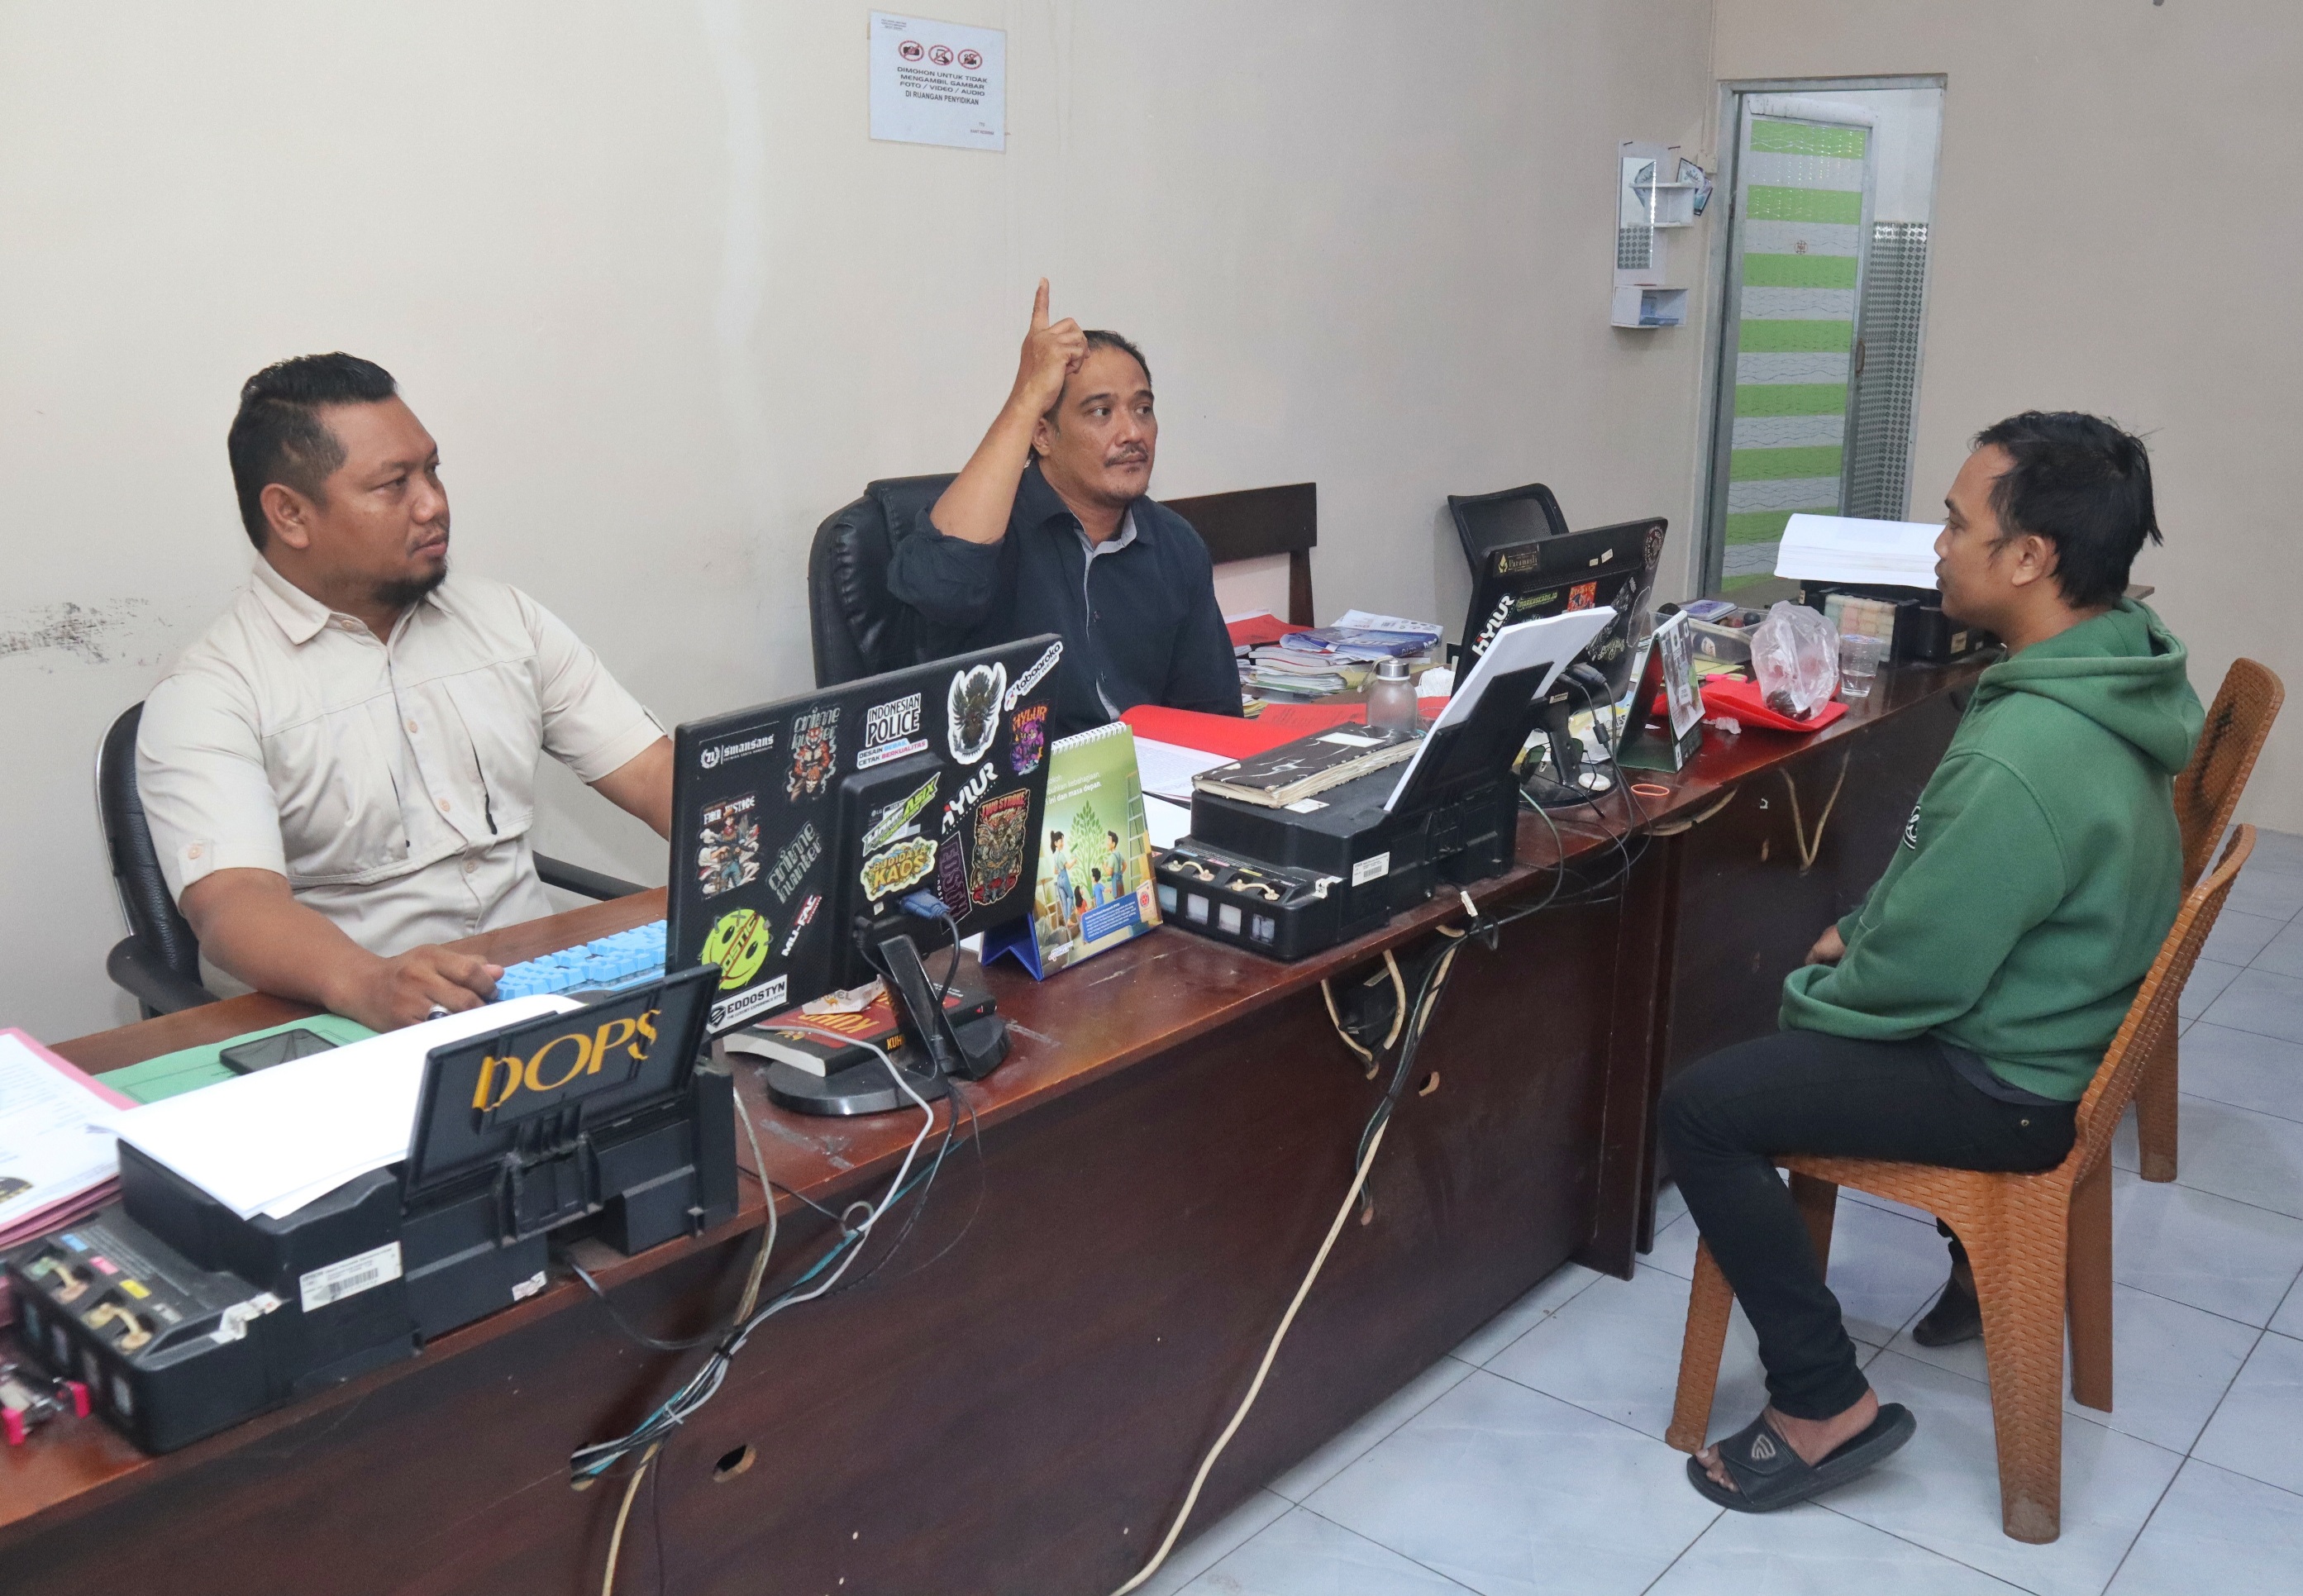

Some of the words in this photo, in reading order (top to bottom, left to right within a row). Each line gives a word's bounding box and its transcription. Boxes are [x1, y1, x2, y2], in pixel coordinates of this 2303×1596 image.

[897, 66, 935, 76] DIMOHON
[900, 74, 948, 85] MENGAMBIL
[951, 81, 985, 89] GAMBAR
[913, 92, 942, 101] RUANGAN
[944, 95, 979, 105] PENYIDIKAN
[869, 694, 920, 722] INDONESIAN
[867, 708, 919, 746] POLICE
[858, 755, 880, 766] CETAK
[881, 741, 926, 760] BERKUALITAS
[859, 747, 883, 759] DESAIN
[1057, 793, 1068, 802] dan
[1068, 788, 1083, 798] masa
[1083, 781, 1103, 792] depan.
[874, 855, 926, 889] KAOS
[727, 981, 785, 1014] EDDOSTYN
[472, 1009, 661, 1112] DOPS
